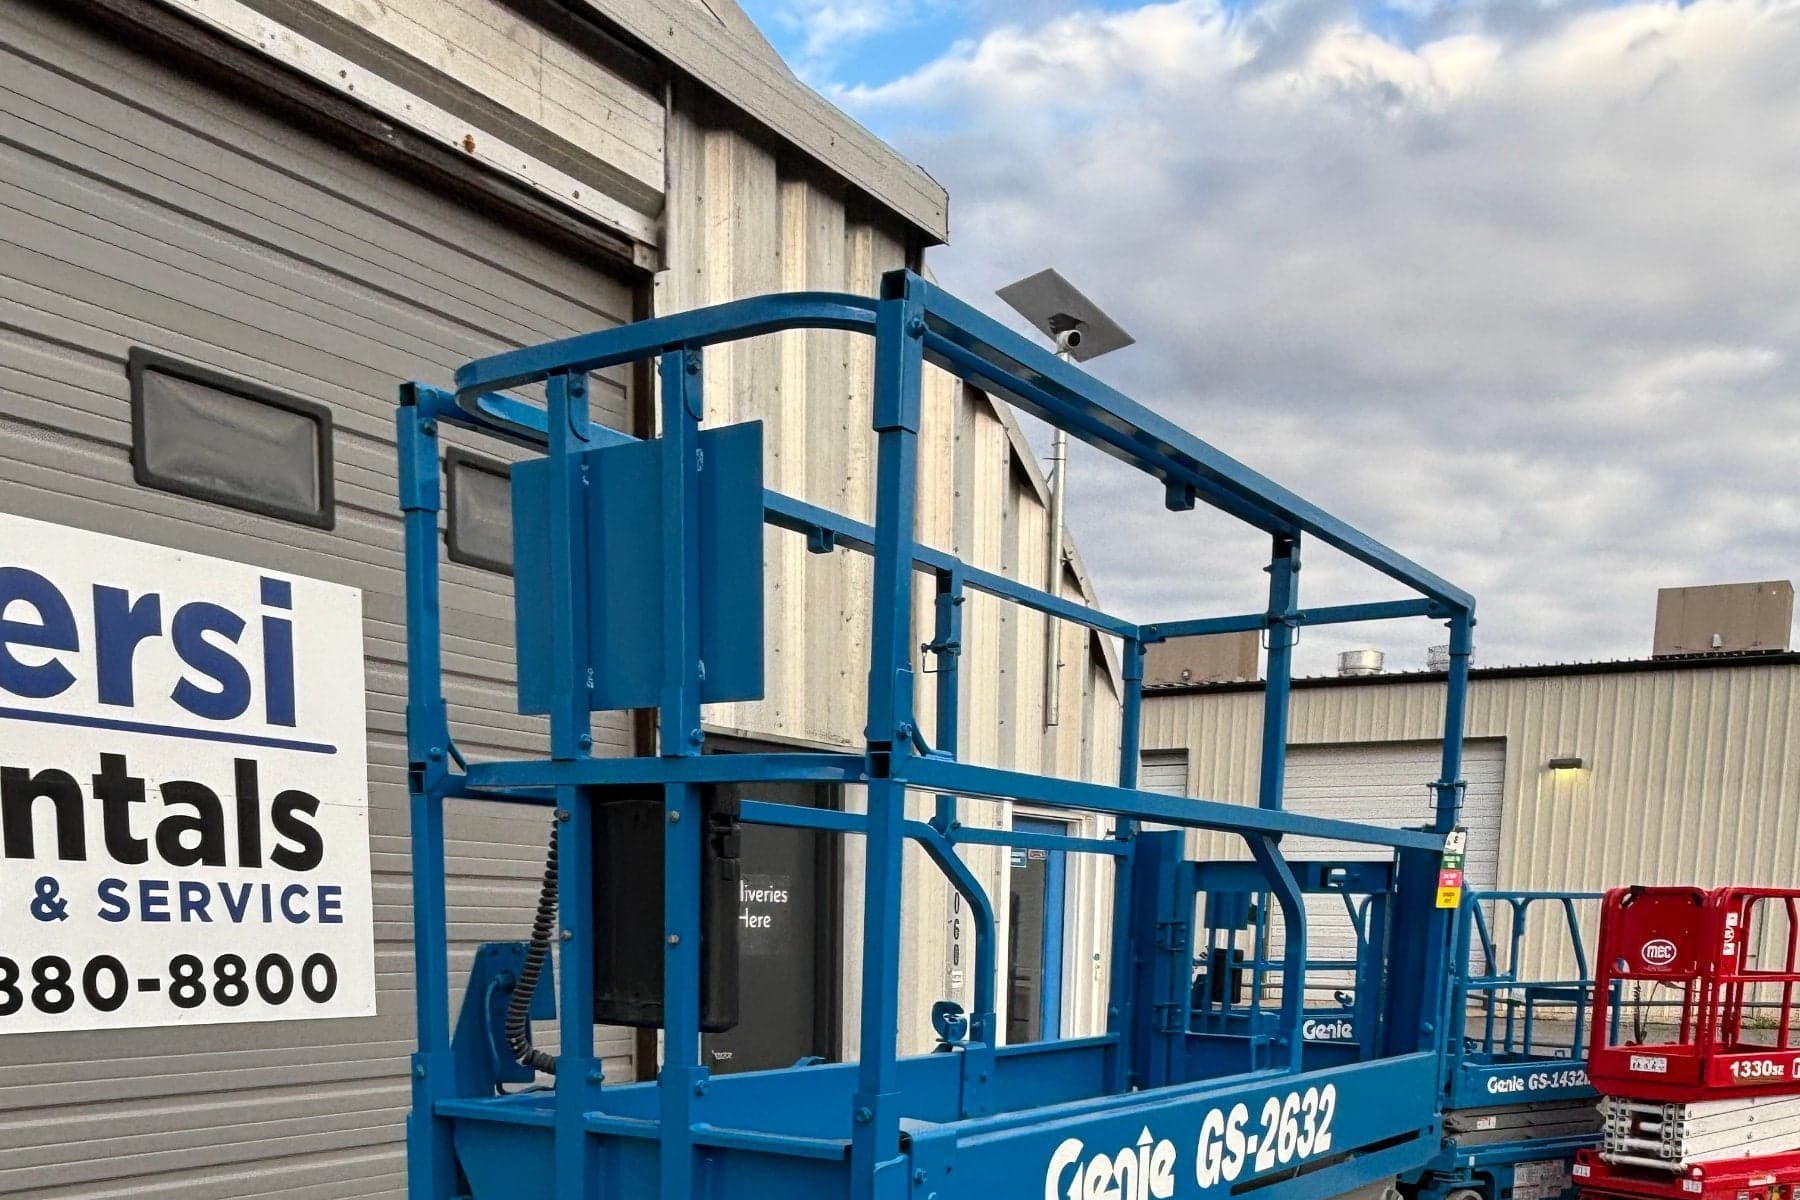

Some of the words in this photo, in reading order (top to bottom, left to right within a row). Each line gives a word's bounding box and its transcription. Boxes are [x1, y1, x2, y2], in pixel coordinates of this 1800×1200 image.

[0, 566, 297, 728] ersi
[0, 752, 324, 871] ntals
[30, 876, 69, 922] &
[98, 878, 344, 924] SERVICE
[1647, 945, 1672, 959] MEC
[1303, 1019, 1352, 1040] Genie
[1487, 1075, 1525, 1094] Genie
[1196, 1083, 1336, 1189] GS-2632
